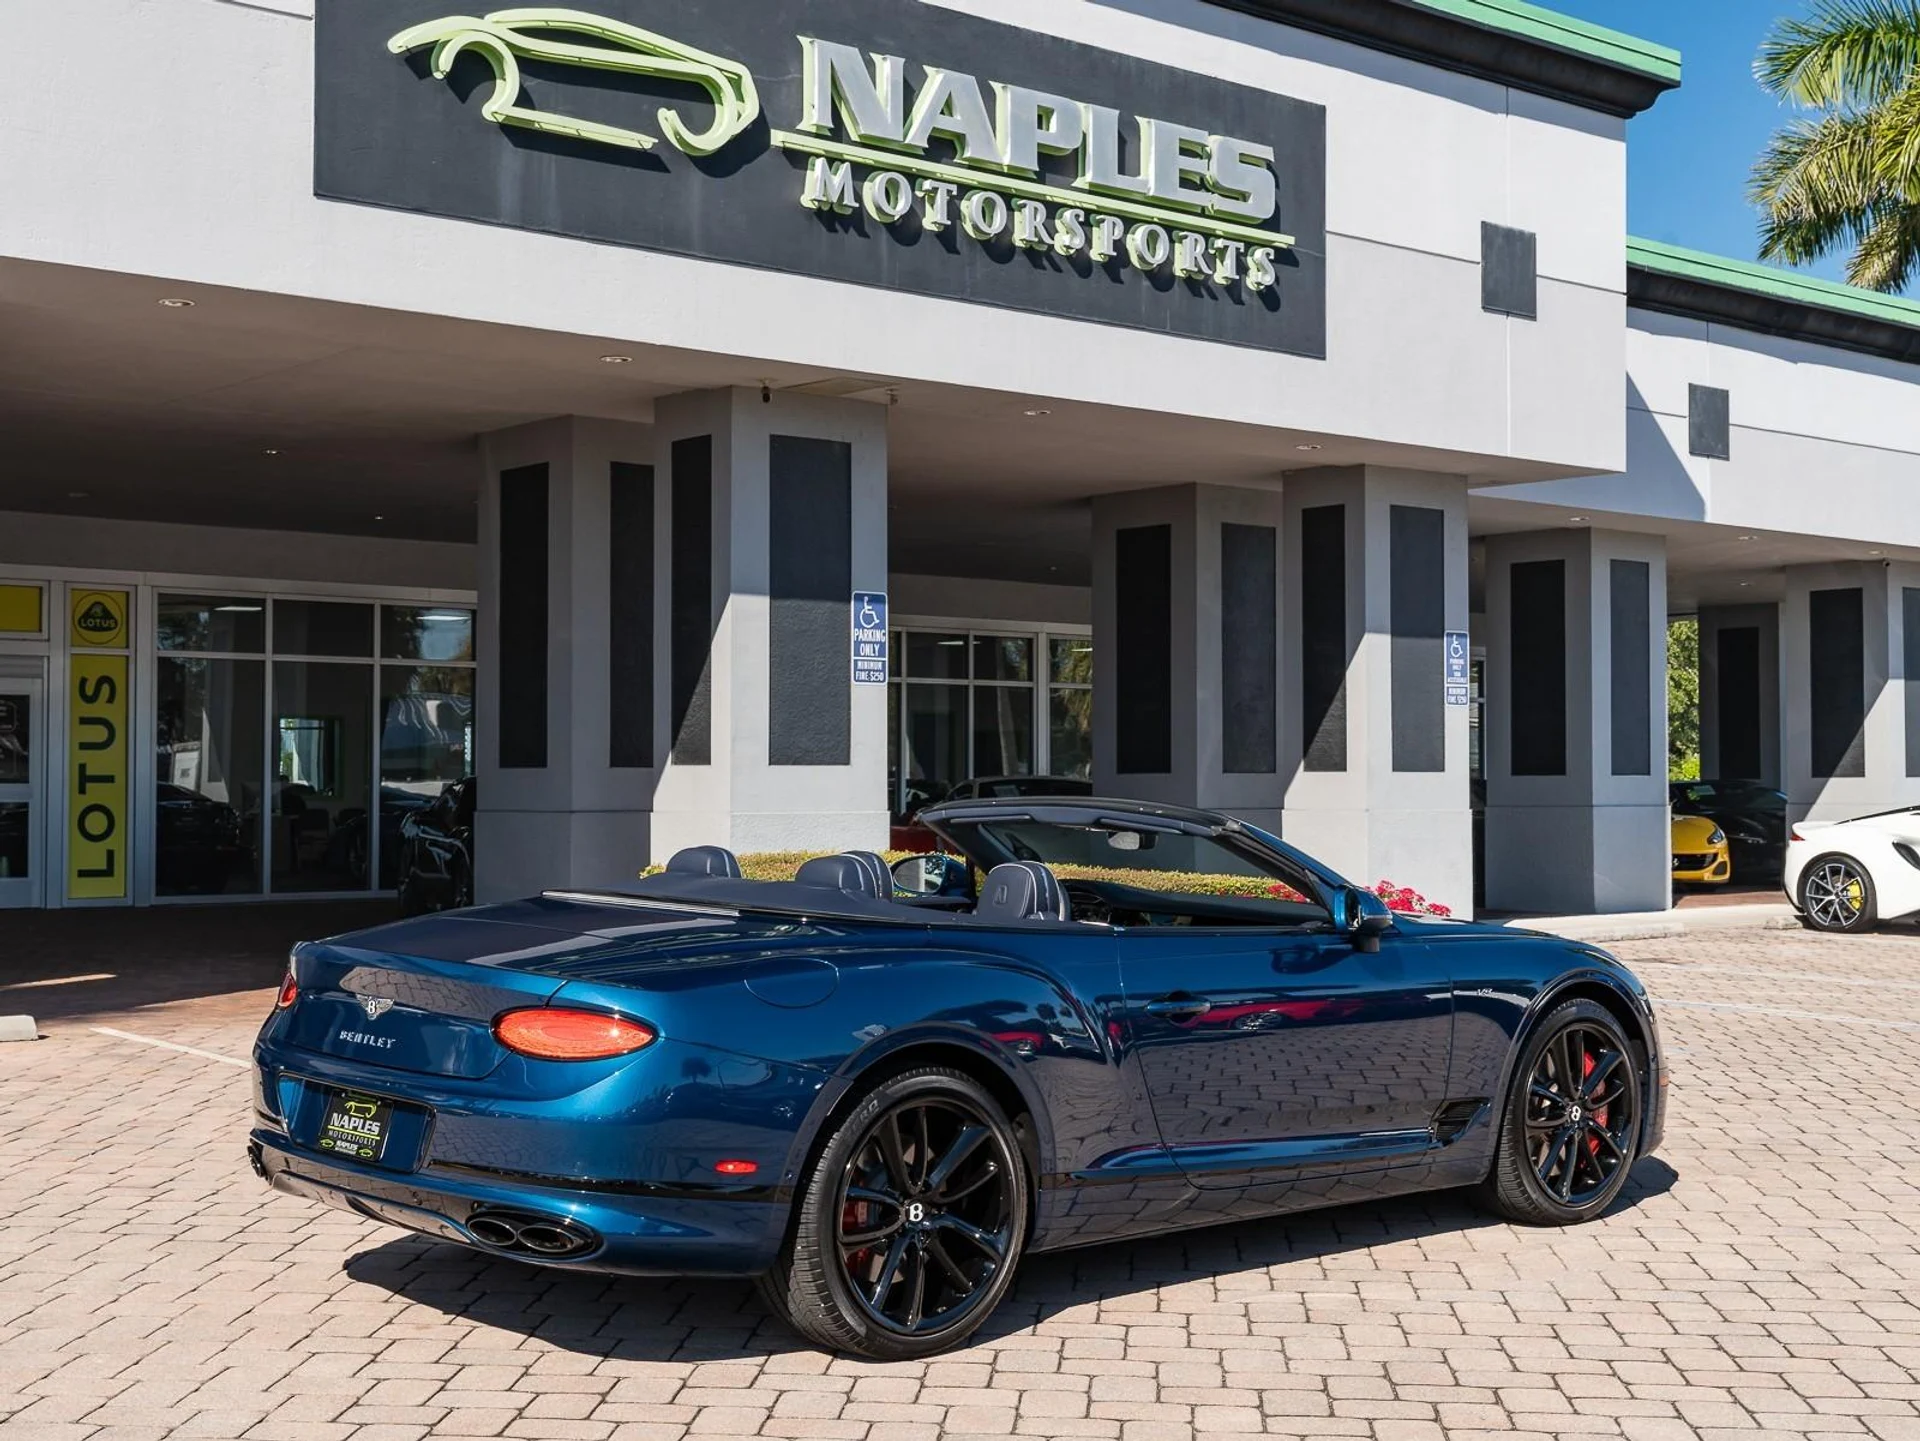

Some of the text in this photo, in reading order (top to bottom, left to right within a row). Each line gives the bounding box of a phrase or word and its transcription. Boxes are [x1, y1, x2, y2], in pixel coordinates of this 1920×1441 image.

[797, 35, 1275, 224] NAPLES
[800, 156, 1277, 291] MOTORSPORTS
[81, 618, 116, 628] LOTUS
[855, 629, 886, 643] PARKING
[860, 644, 880, 657] ONLY
[857, 661, 883, 670] MINIMUM
[855, 671, 884, 682] FINE $250
[77, 675, 117, 878] LOTUS
[339, 1030, 396, 1049] BENTLEY
[330, 1112, 381, 1136] NAPLES
[328, 1130, 376, 1146] MOTORSPORTS
[909, 1203, 924, 1222] B
